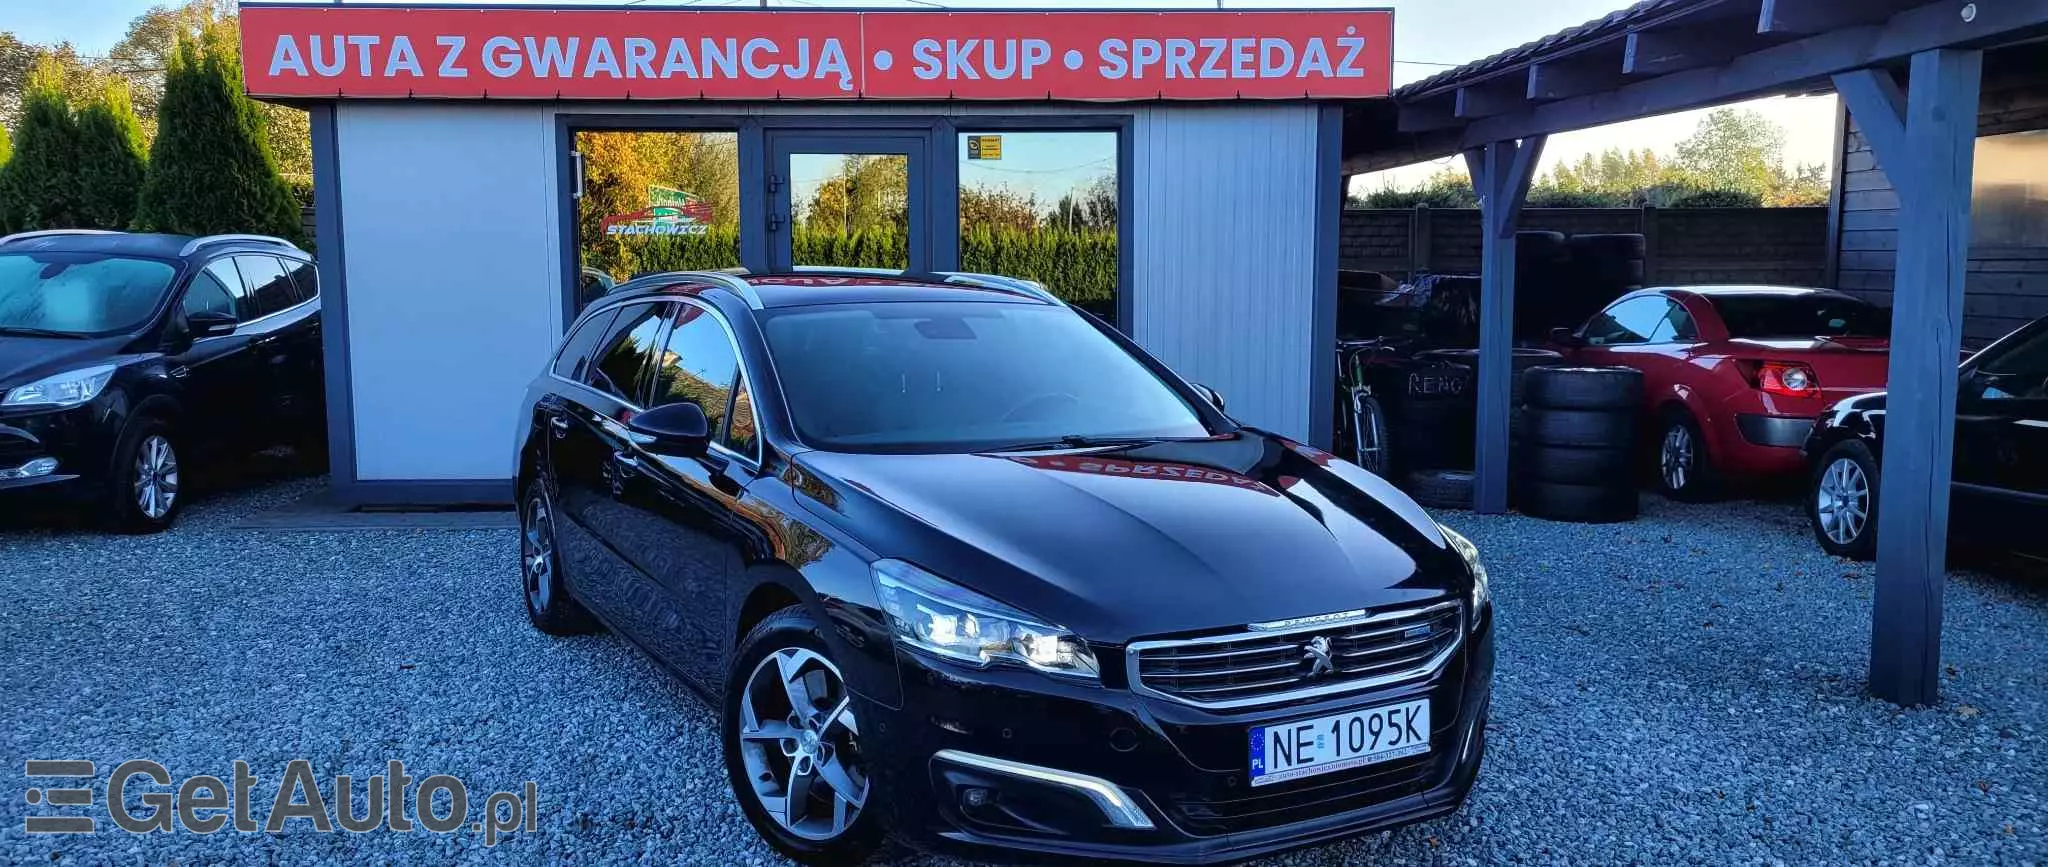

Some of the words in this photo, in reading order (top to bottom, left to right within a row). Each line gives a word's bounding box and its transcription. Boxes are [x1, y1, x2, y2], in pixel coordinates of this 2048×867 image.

[269, 34, 423, 77] AUTA
[437, 35, 466, 78] Z
[481, 36, 854, 91] GWARANCJĄ
[913, 38, 1052, 80] SKUP
[1099, 25, 1365, 79] SPRZEDAŻ
[606, 224, 709, 235] STACHOWICZ
[1273, 724, 1314, 769] NE
[1331, 704, 1422, 757] 1095K
[1251, 758, 1264, 771] PL
